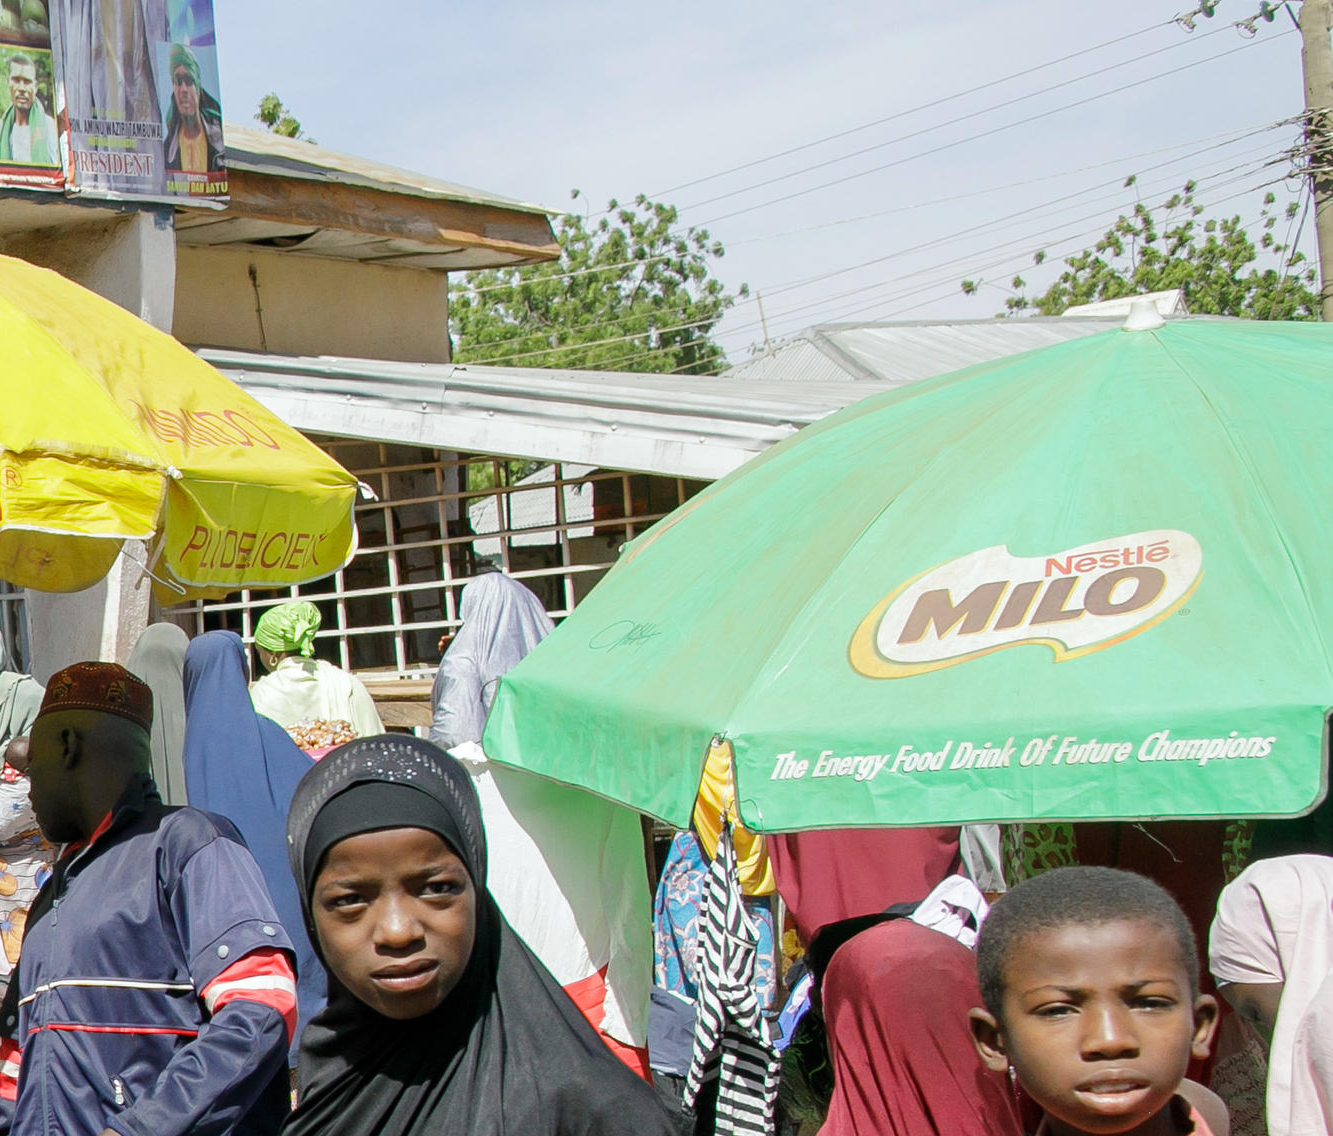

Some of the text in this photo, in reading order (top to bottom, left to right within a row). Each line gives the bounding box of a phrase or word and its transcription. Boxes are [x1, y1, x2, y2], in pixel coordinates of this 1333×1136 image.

[73, 150, 153, 176] PRESIDENT
[1045, 540, 1170, 577] Nestlé
[896, 566, 1167, 644] MILO
[770, 729, 1277, 782] The Energy Food Drink Of Future Champions
